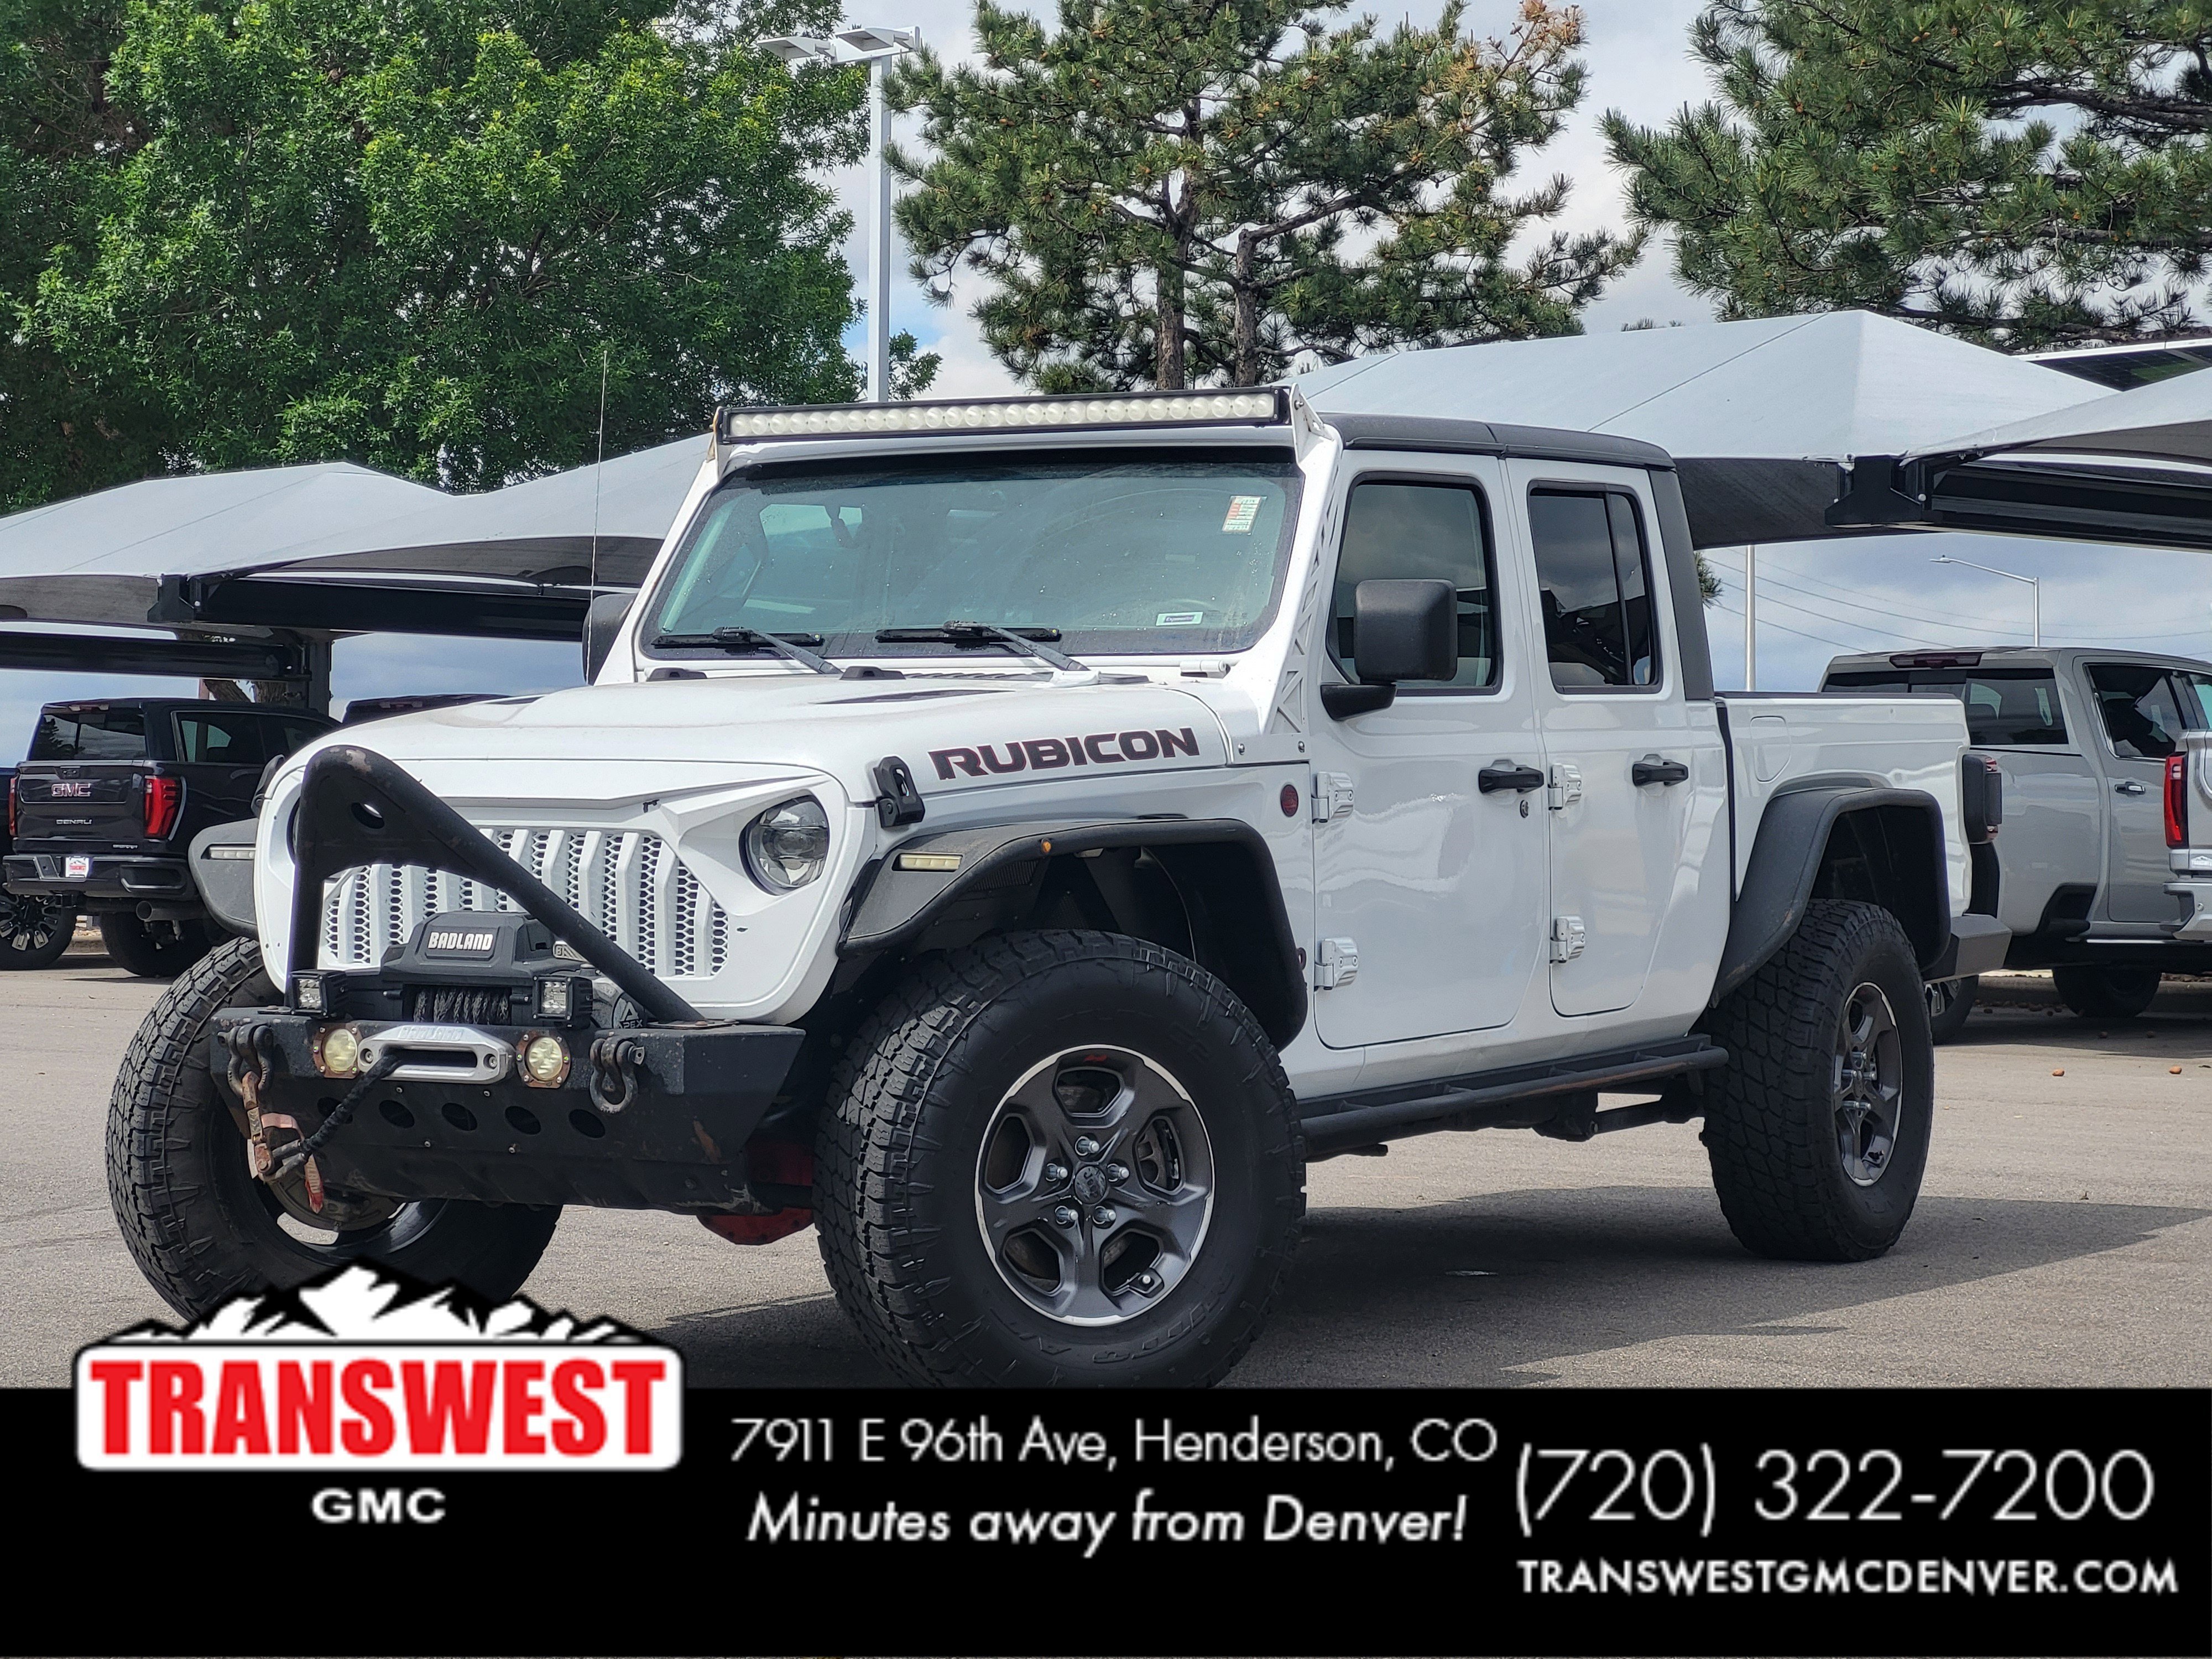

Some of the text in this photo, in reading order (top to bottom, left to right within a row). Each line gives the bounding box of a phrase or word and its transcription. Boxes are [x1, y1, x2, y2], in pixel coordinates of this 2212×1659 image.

[928, 727, 1201, 780] RUBICON
[51, 783, 92, 797] GMC
[427, 932, 494, 951] BADLAND
